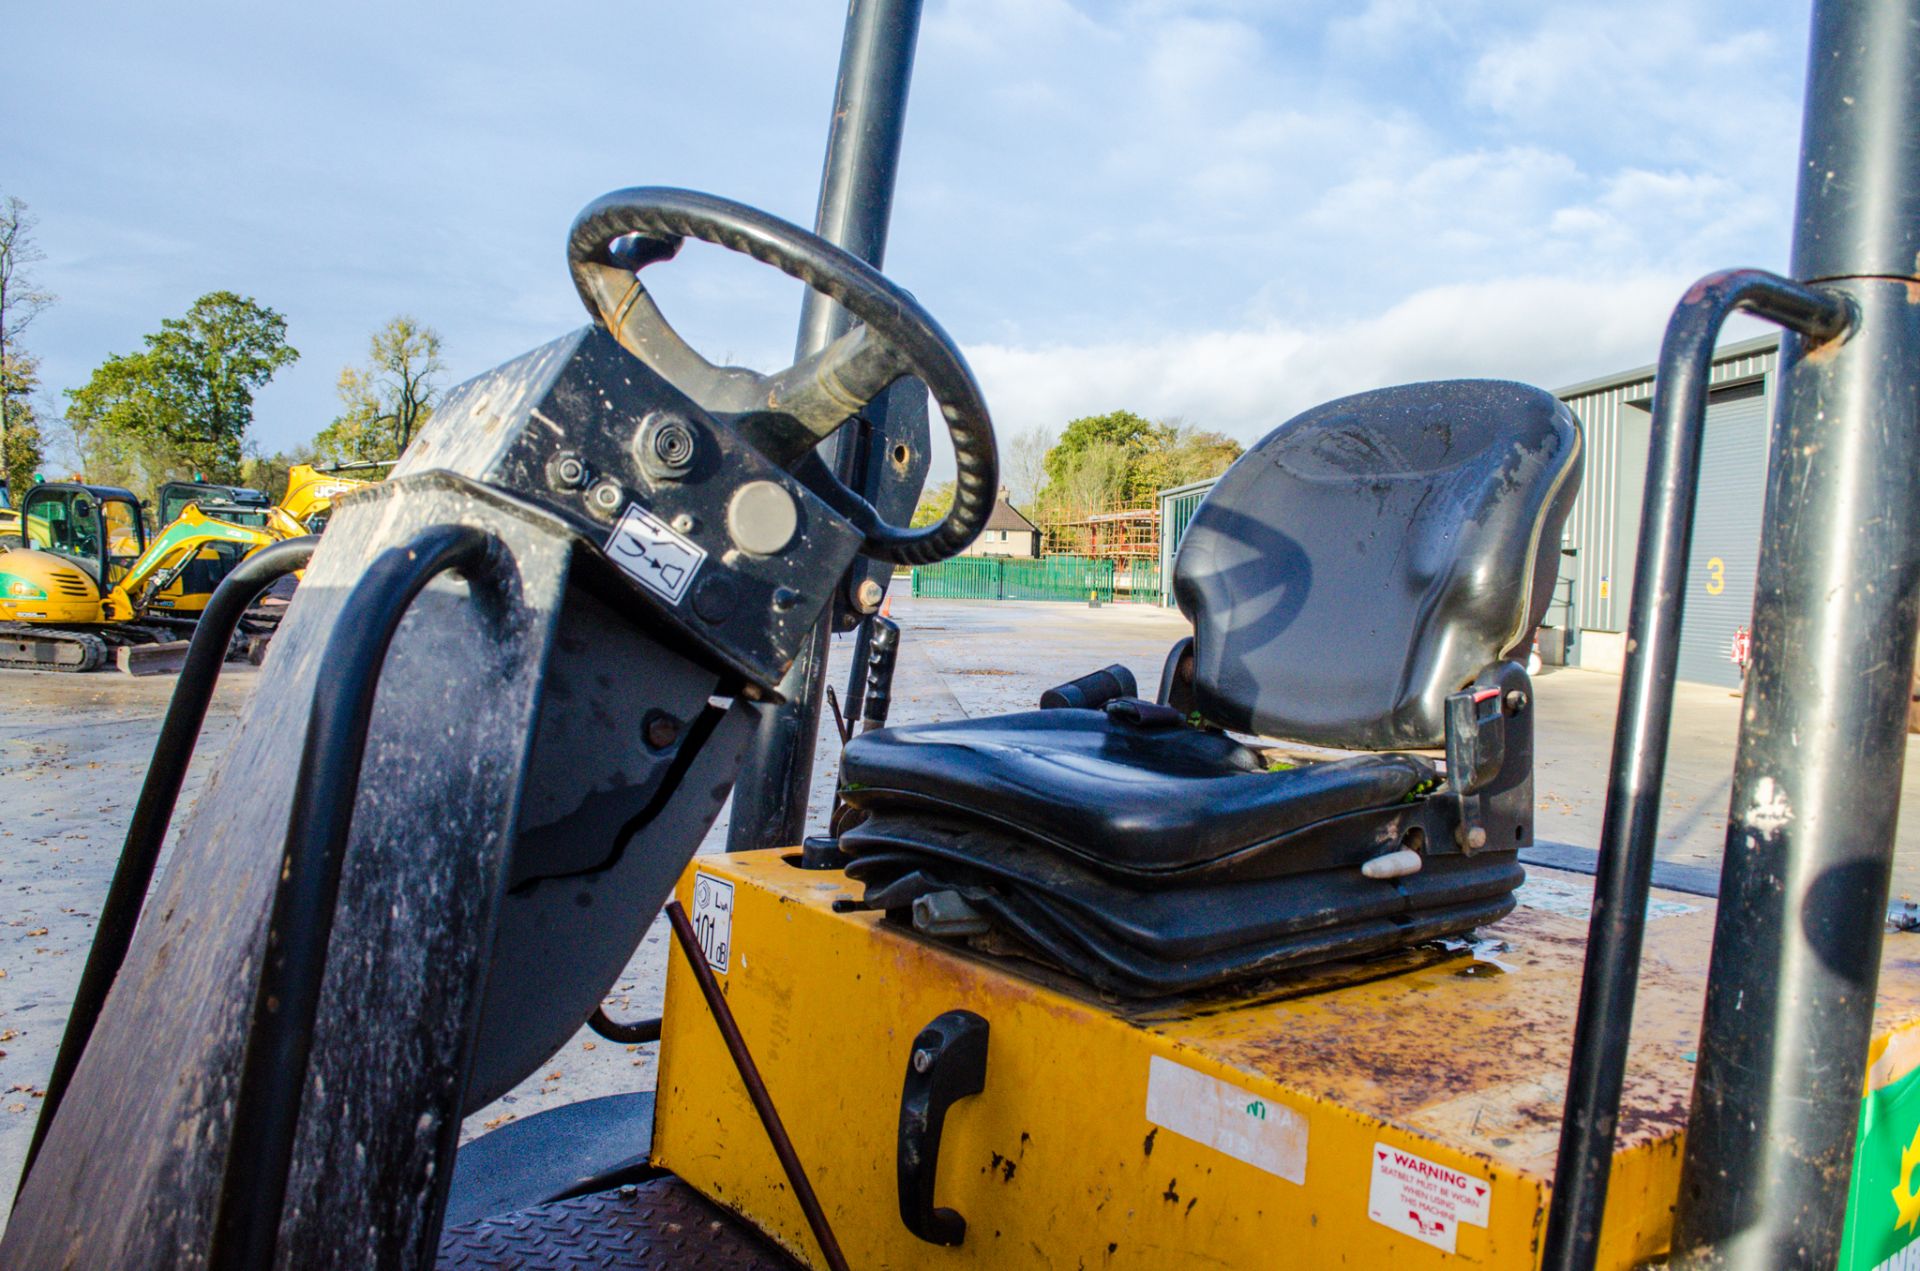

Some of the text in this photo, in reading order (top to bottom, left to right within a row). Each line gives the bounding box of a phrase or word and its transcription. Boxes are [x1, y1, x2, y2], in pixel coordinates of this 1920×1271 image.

[1706, 557, 1725, 595] 3
[716, 942, 726, 964] dB
[1394, 1152, 1466, 1189] WARNING
[1403, 1185, 1456, 1211] WHEN USING
[1416, 1178, 1437, 1192] MUST
[1440, 1187, 1448, 1197] BE
[1452, 1190, 1479, 1208] WORN
[1401, 1194, 1456, 1221] THIS MACHINE
